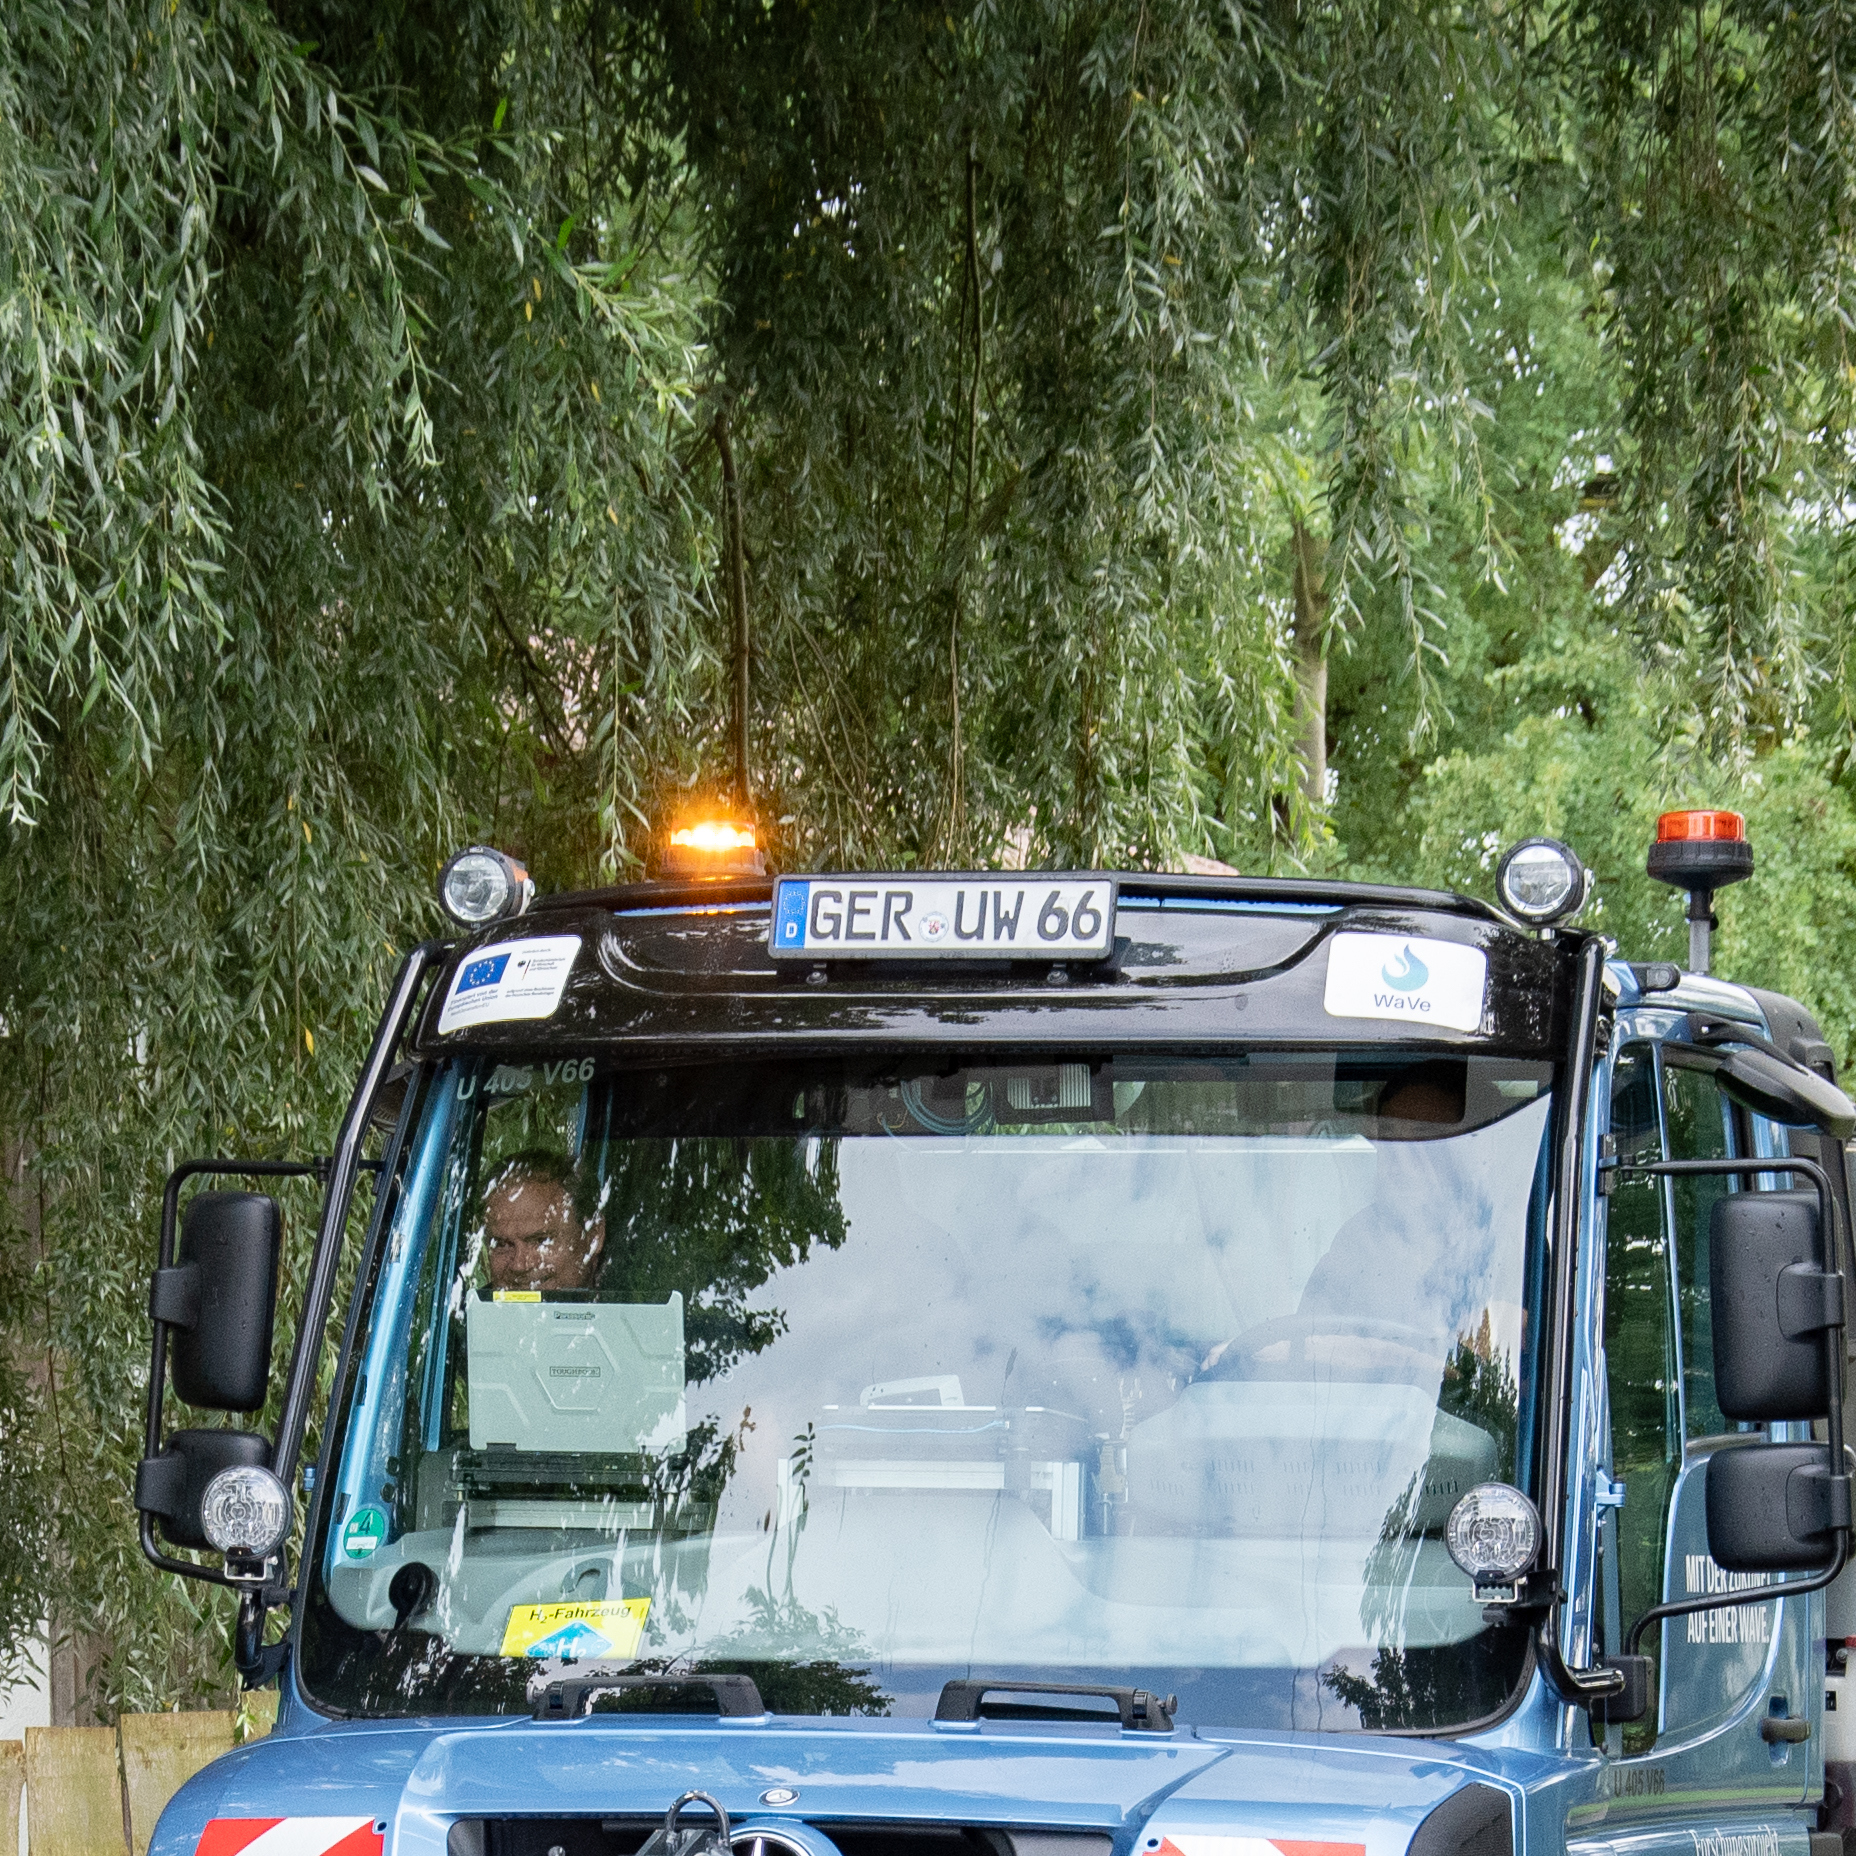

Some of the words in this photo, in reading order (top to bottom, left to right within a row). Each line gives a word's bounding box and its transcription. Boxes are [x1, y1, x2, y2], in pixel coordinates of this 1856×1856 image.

[785, 922, 798, 938] D
[809, 890, 914, 941] GER
[954, 890, 1025, 941] UW
[1036, 890, 1102, 941] 66
[1374, 993, 1431, 1012] WaVe
[457, 1075, 477, 1100] U
[483, 1063, 534, 1094] 405
[543, 1056, 596, 1086] V66
[358, 1511, 374, 1535] 4
[1685, 1554, 1706, 1593] MIT
[1687, 1608, 1708, 1644] AUF
[1708, 1605, 1738, 1644] EINER
[1738, 1605, 1770, 1644] WAVE.
[1614, 1769, 1622, 1798] U
[1625, 1768, 1644, 1797] 405
[1646, 1768, 1665, 1796] V66
